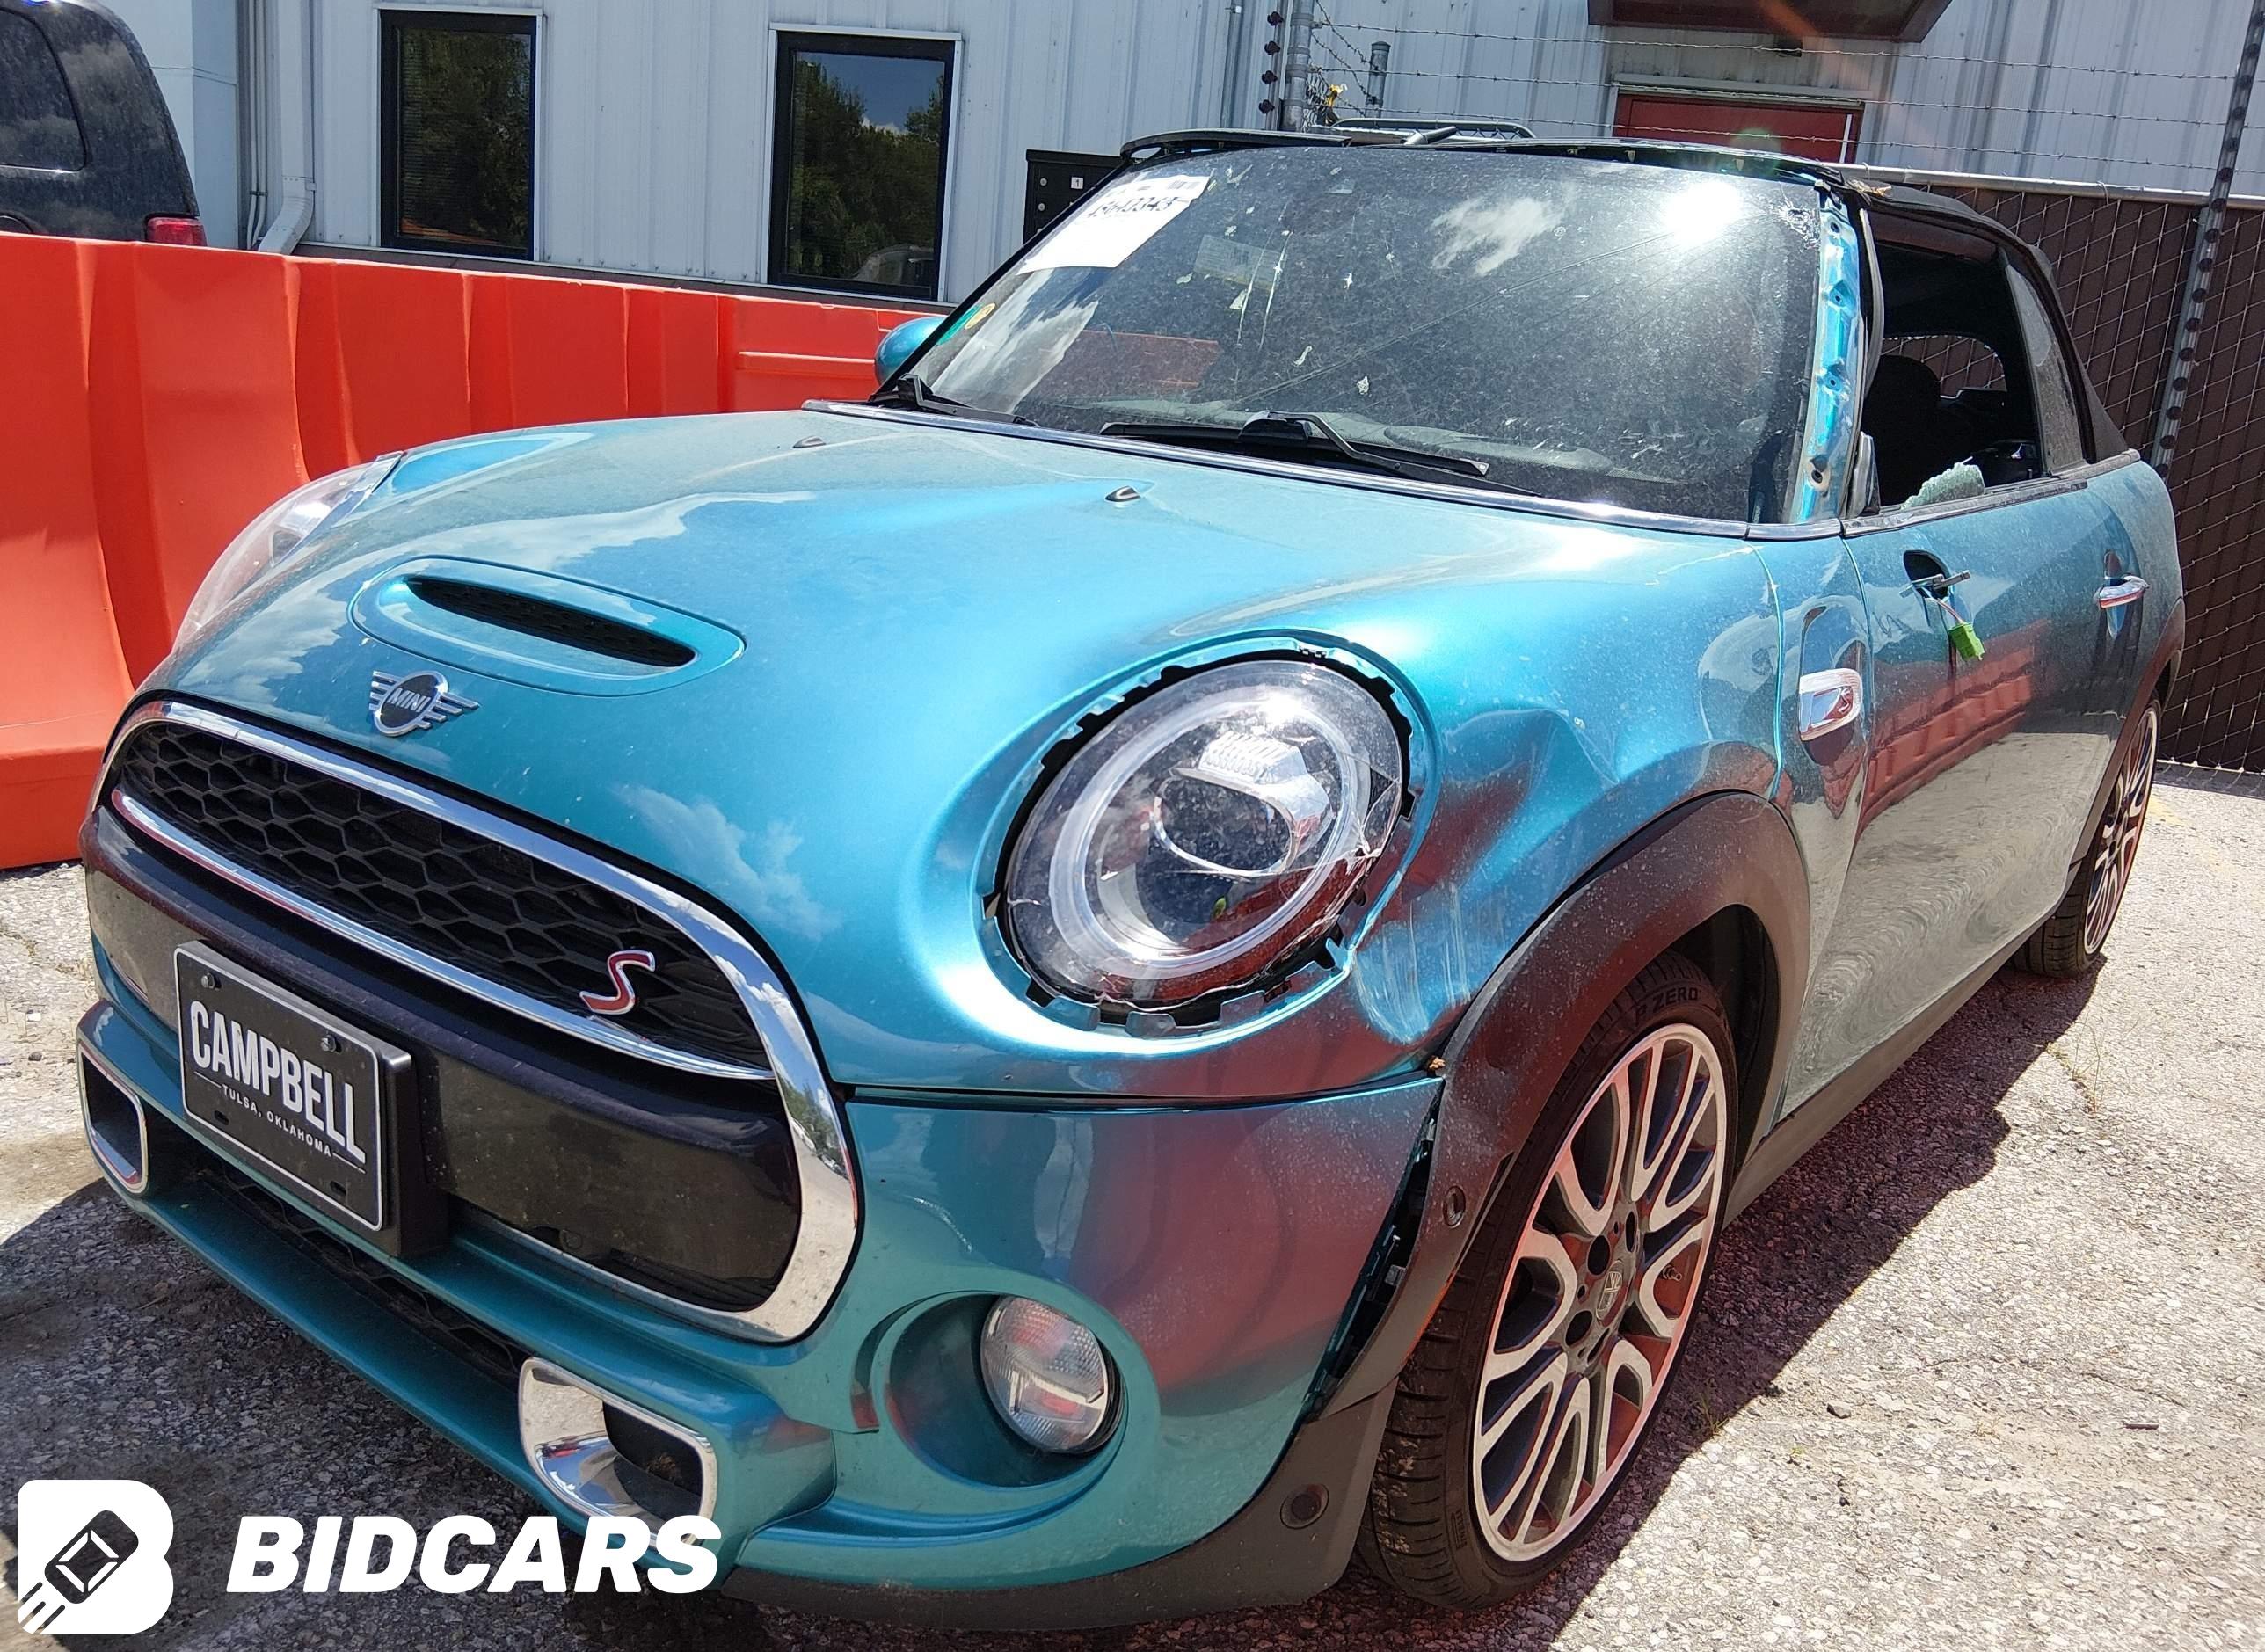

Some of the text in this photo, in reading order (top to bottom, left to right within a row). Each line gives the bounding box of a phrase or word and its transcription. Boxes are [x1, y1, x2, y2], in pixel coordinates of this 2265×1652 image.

[388, 688, 431, 713] MINI
[579, 950, 656, 1015] S
[1652, 986, 1699, 1014] ZERO
[190, 1001, 366, 1164] CAMPBELL
[222, 1084, 333, 1158] TULSA, OKLAHOMA
